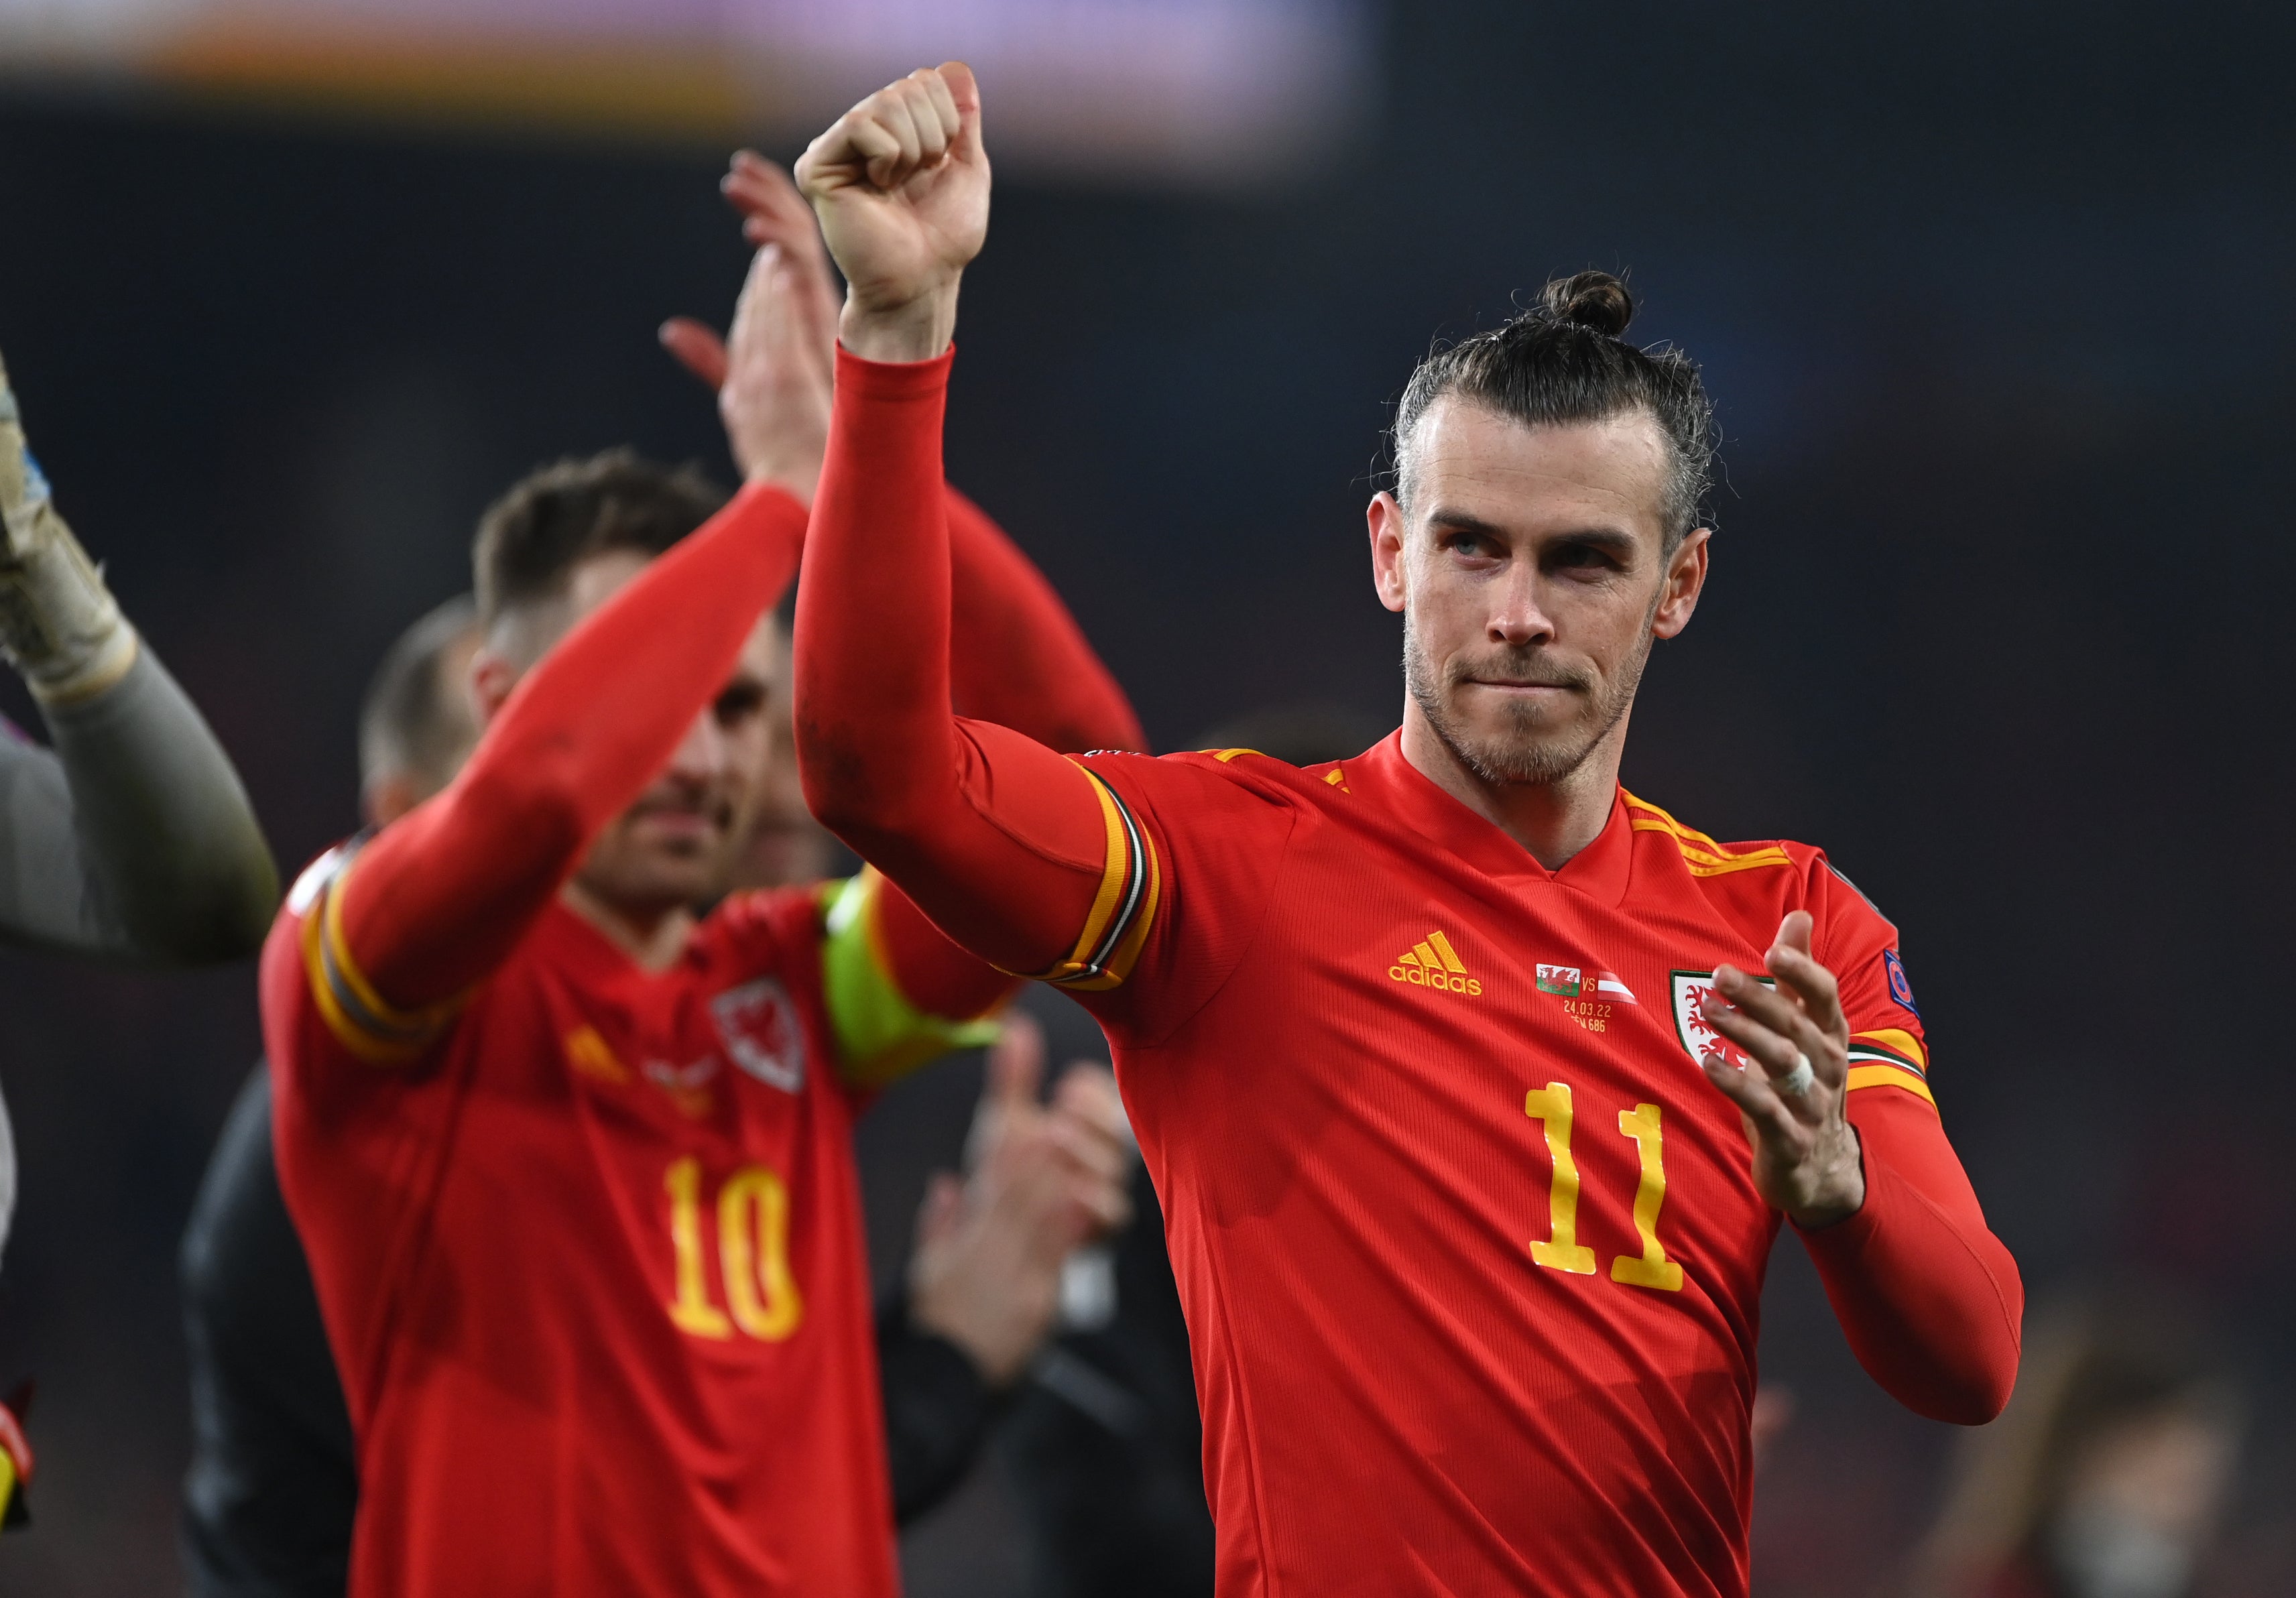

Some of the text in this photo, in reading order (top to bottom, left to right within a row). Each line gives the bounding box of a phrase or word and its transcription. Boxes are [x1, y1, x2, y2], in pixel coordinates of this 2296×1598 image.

[1388, 965, 1482, 995] adidas
[1582, 977, 1595, 991] VS
[1564, 999, 1611, 1018] 24.03.22
[1588, 1018, 1605, 1032] 686
[1525, 1082, 1683, 1291] 11
[664, 1154, 800, 1341] 10
